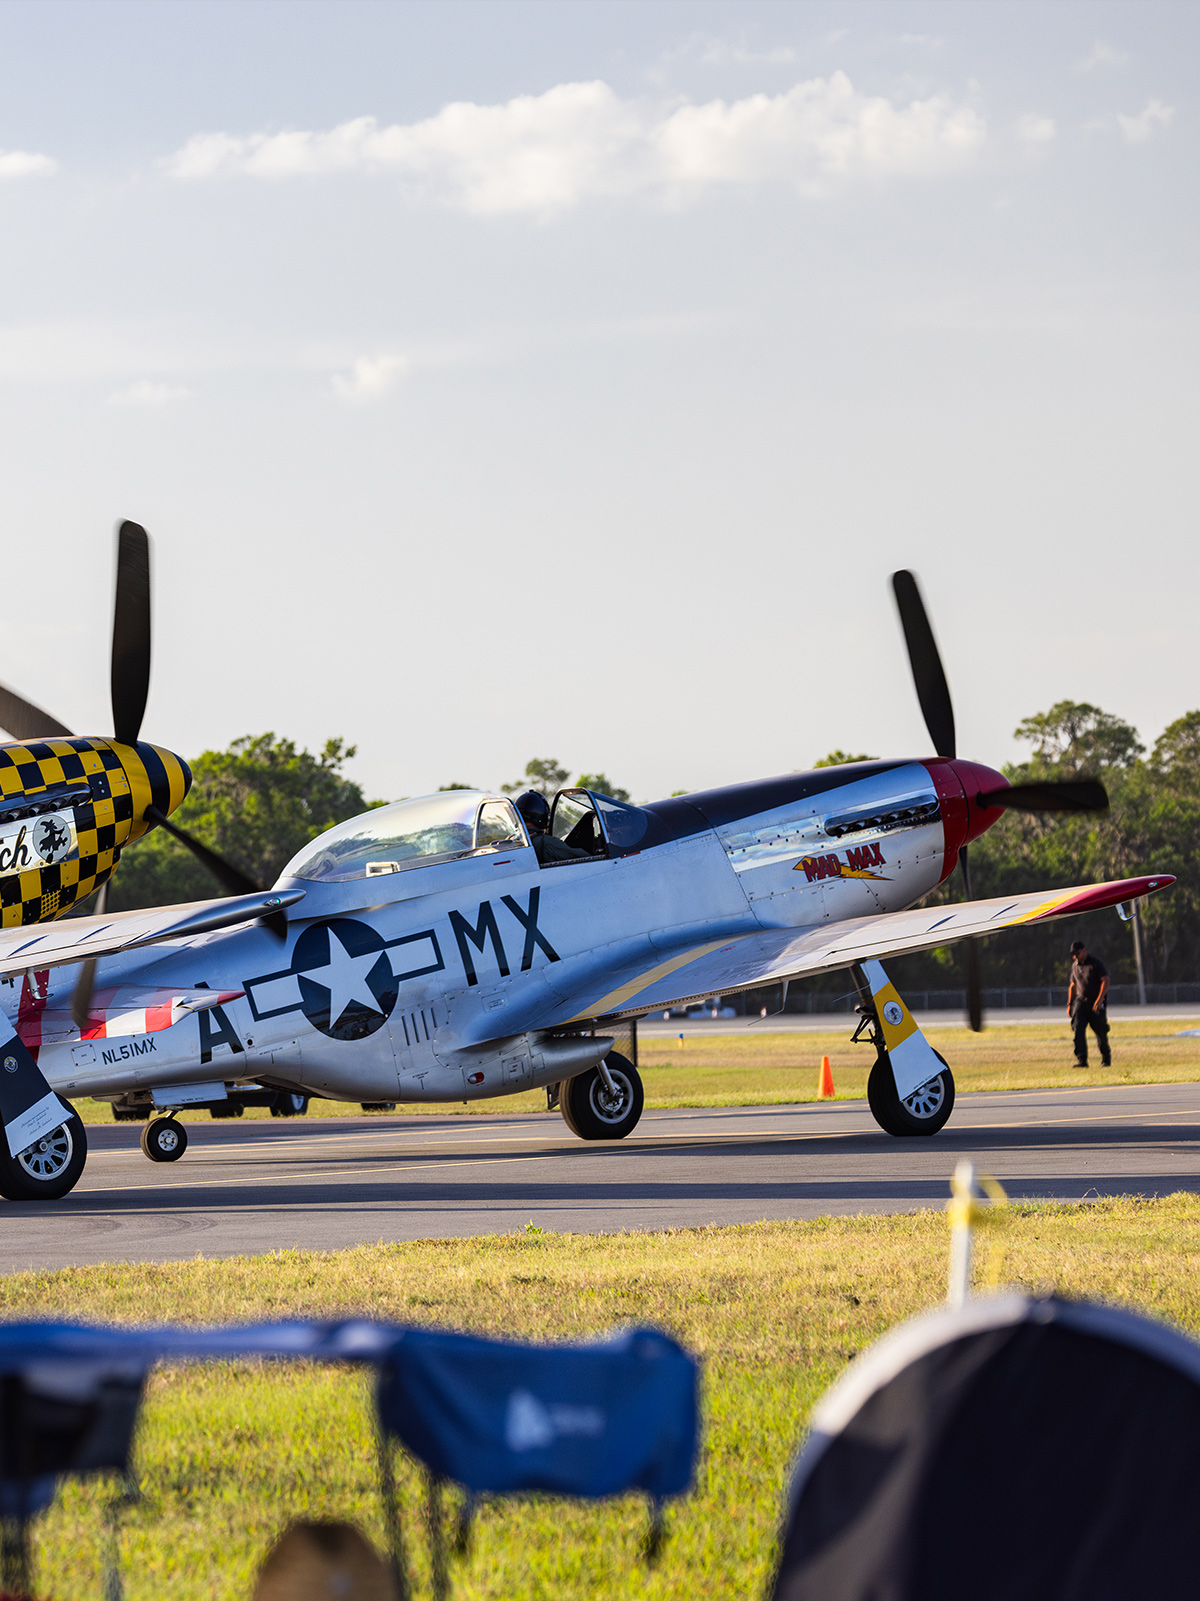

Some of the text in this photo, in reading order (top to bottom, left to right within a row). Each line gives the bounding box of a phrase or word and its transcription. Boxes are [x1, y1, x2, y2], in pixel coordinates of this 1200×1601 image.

[801, 842, 887, 883] MAD MAX
[448, 886, 562, 987] MX
[194, 981, 245, 1064] A
